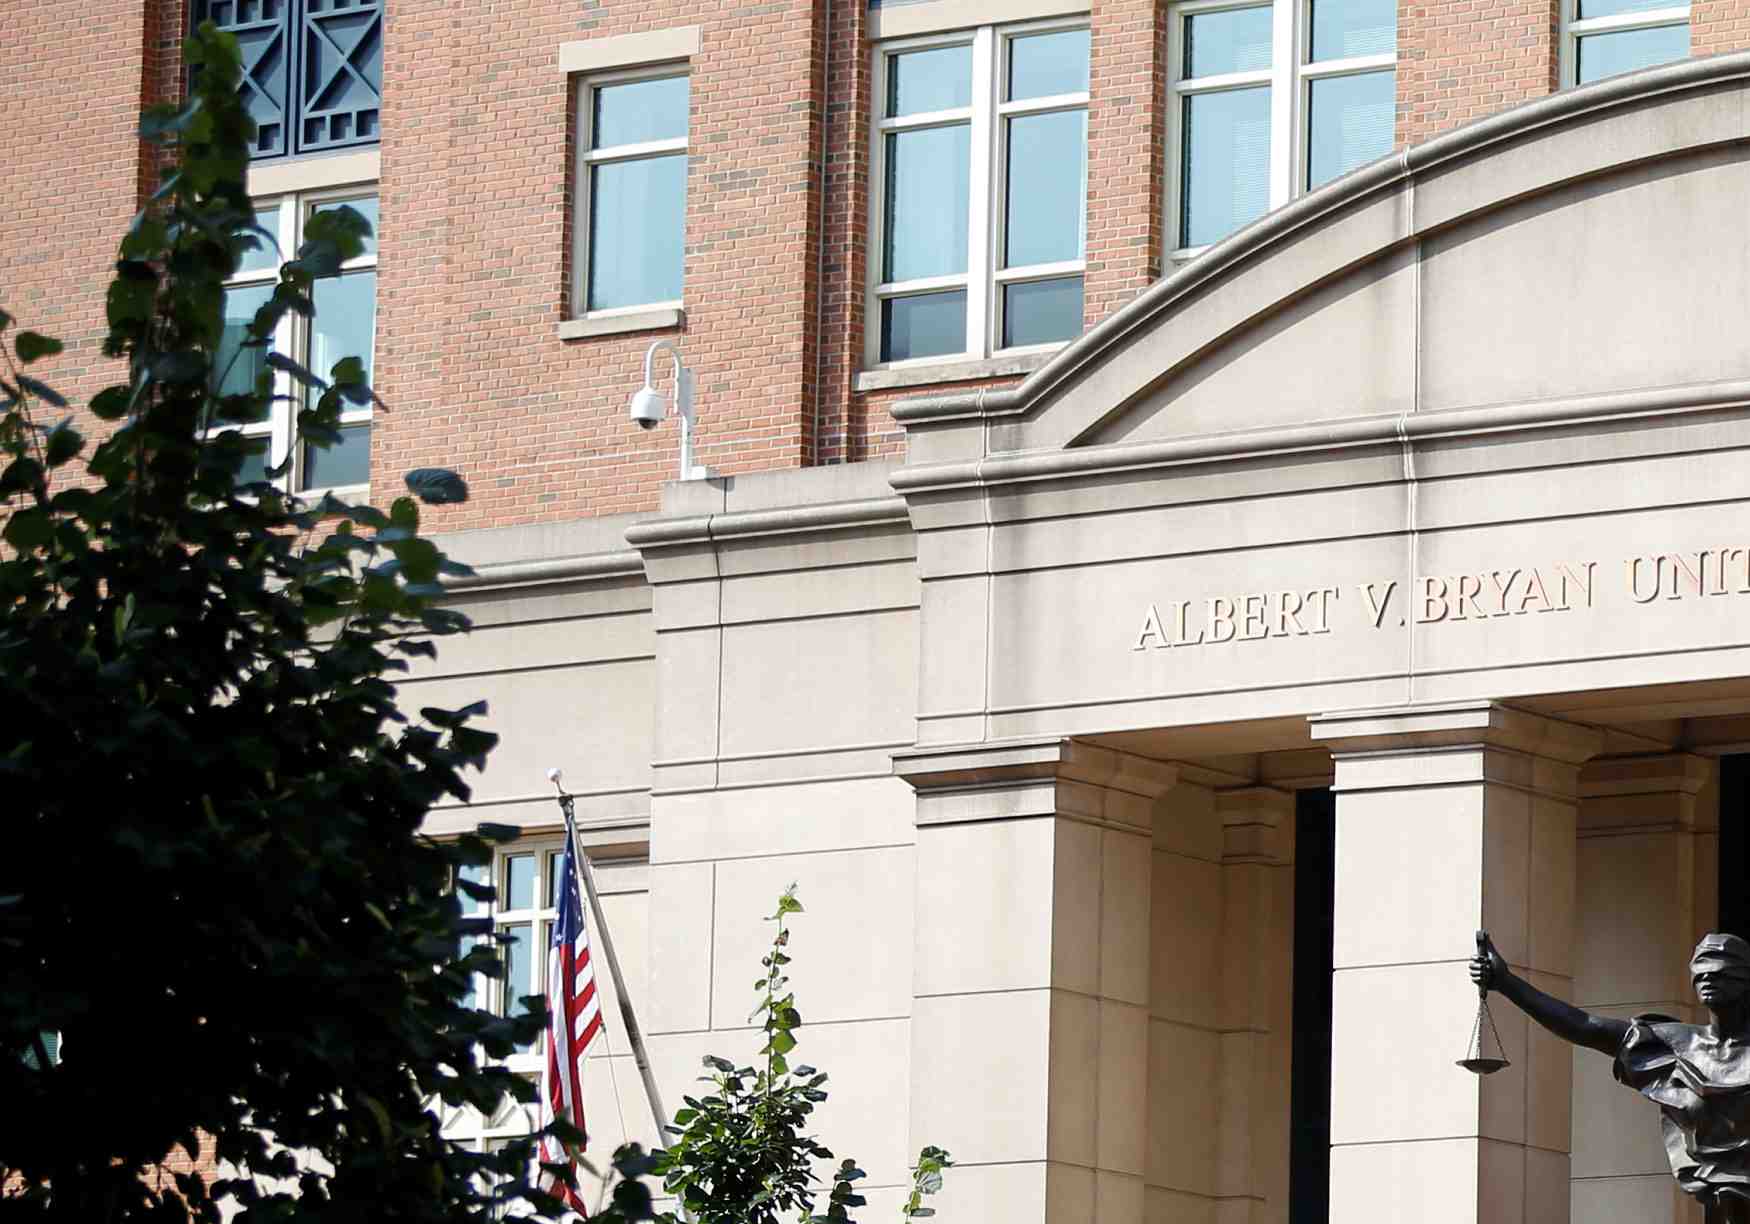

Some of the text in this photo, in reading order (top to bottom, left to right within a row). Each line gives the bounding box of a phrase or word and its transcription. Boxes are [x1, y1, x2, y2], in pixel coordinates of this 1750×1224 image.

[1131, 586, 1340, 652] ALBERT
[1357, 583, 1407, 630] V.
[1413, 561, 1598, 625] BRYAN
